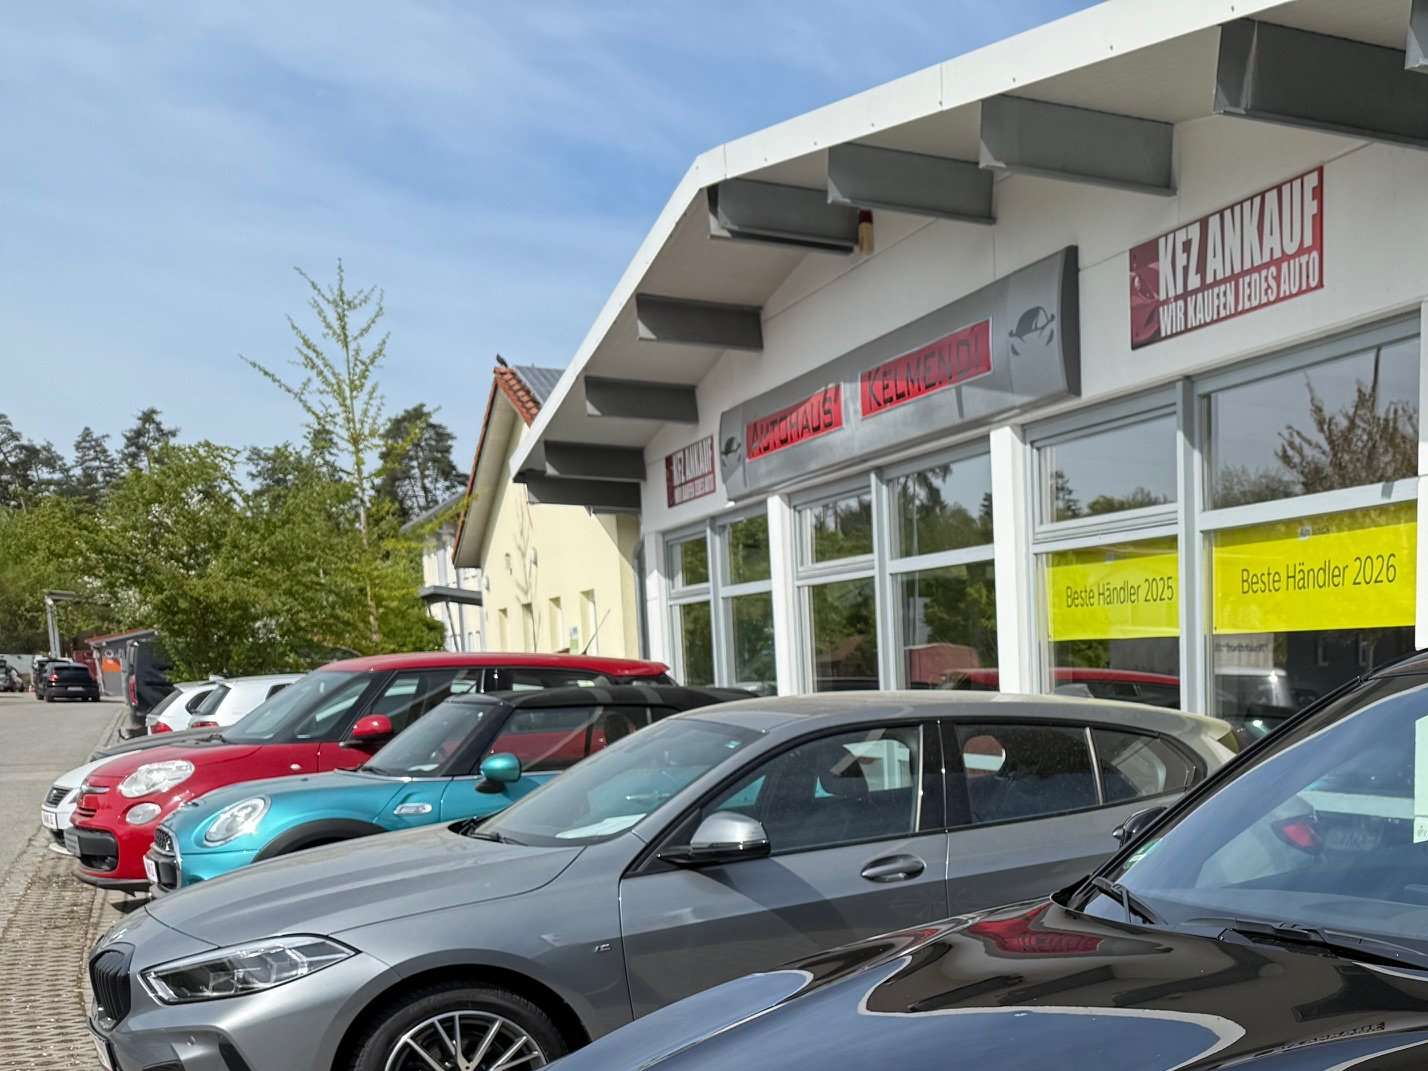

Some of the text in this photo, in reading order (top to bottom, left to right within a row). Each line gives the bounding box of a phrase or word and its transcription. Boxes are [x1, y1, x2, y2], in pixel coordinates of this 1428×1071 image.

[1158, 171, 1319, 301] KFZ ANKAUF
[1160, 251, 1319, 337] WIR KAUFEN JEDES AUTO
[1066, 576, 1175, 608] Beste Händler 2025
[1241, 553, 1397, 595] Beste Händler 2026
